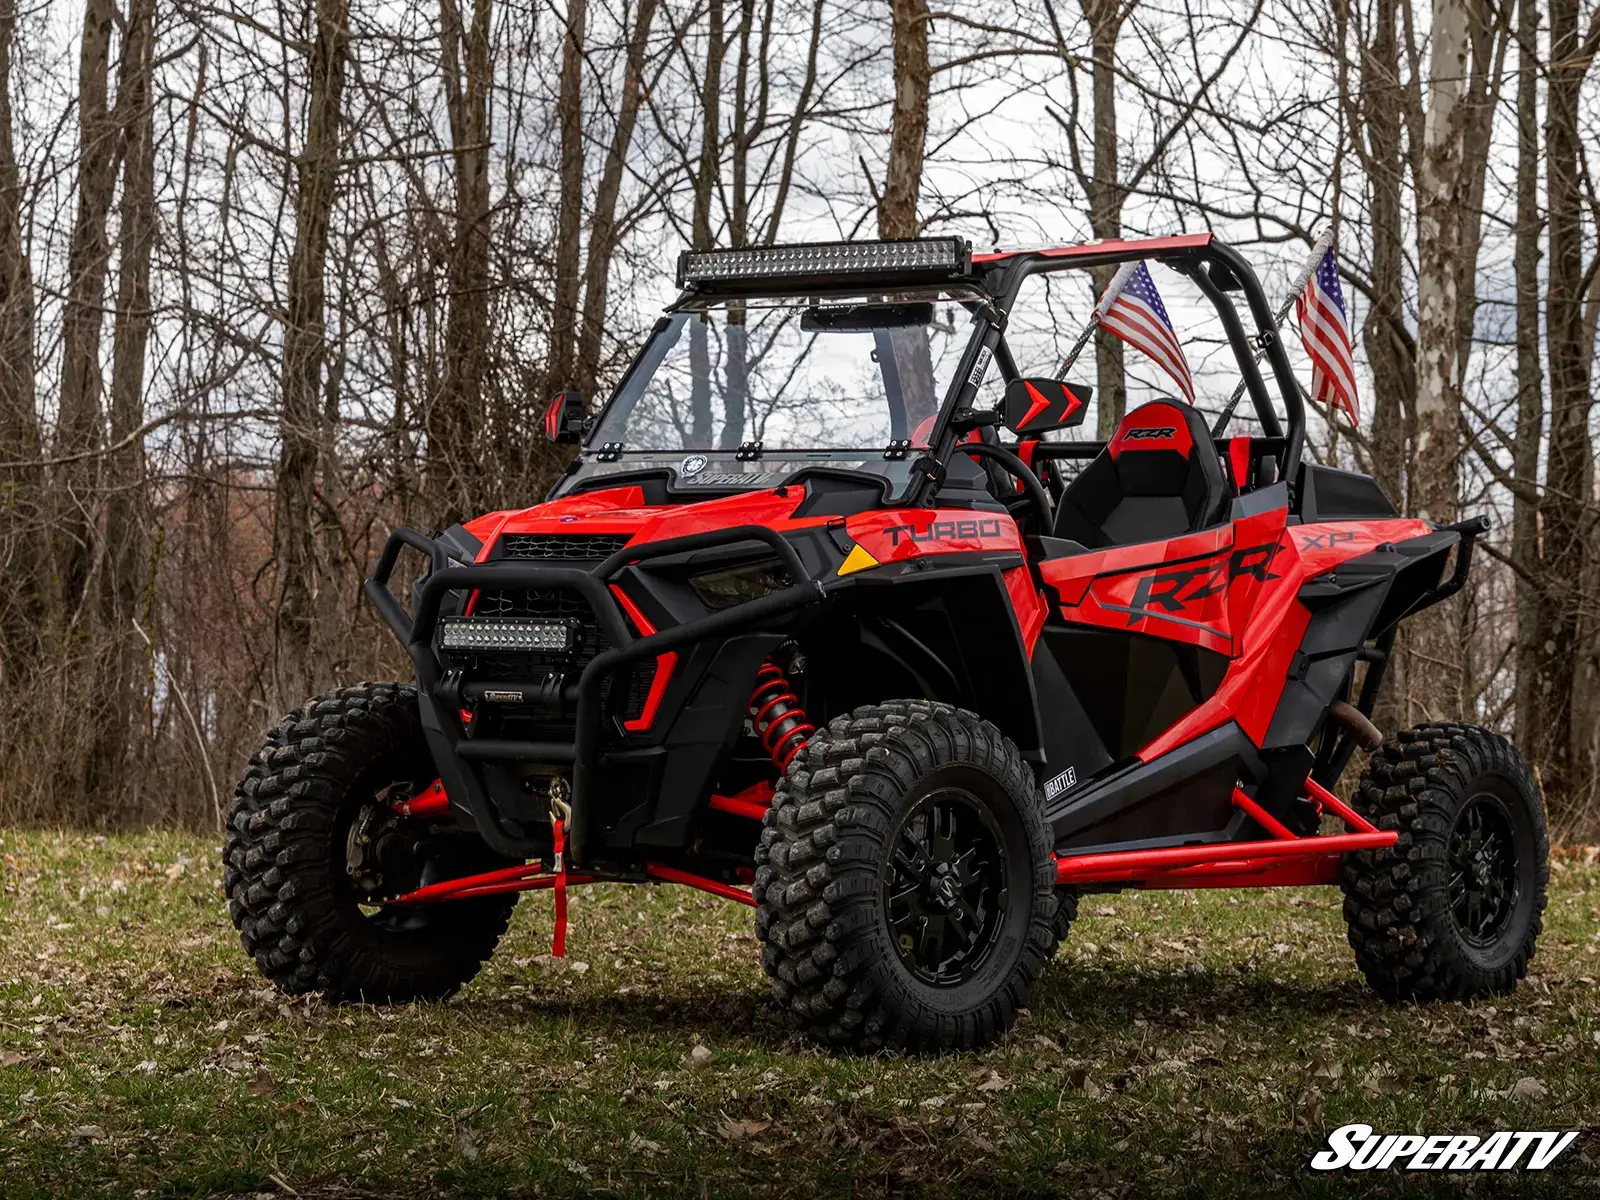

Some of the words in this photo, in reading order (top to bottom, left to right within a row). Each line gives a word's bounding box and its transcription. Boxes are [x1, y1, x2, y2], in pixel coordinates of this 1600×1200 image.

[1122, 427, 1177, 442] RZR
[882, 519, 1001, 547] TURBO
[1301, 531, 1354, 552] XP
[1125, 541, 1286, 627] RZR
